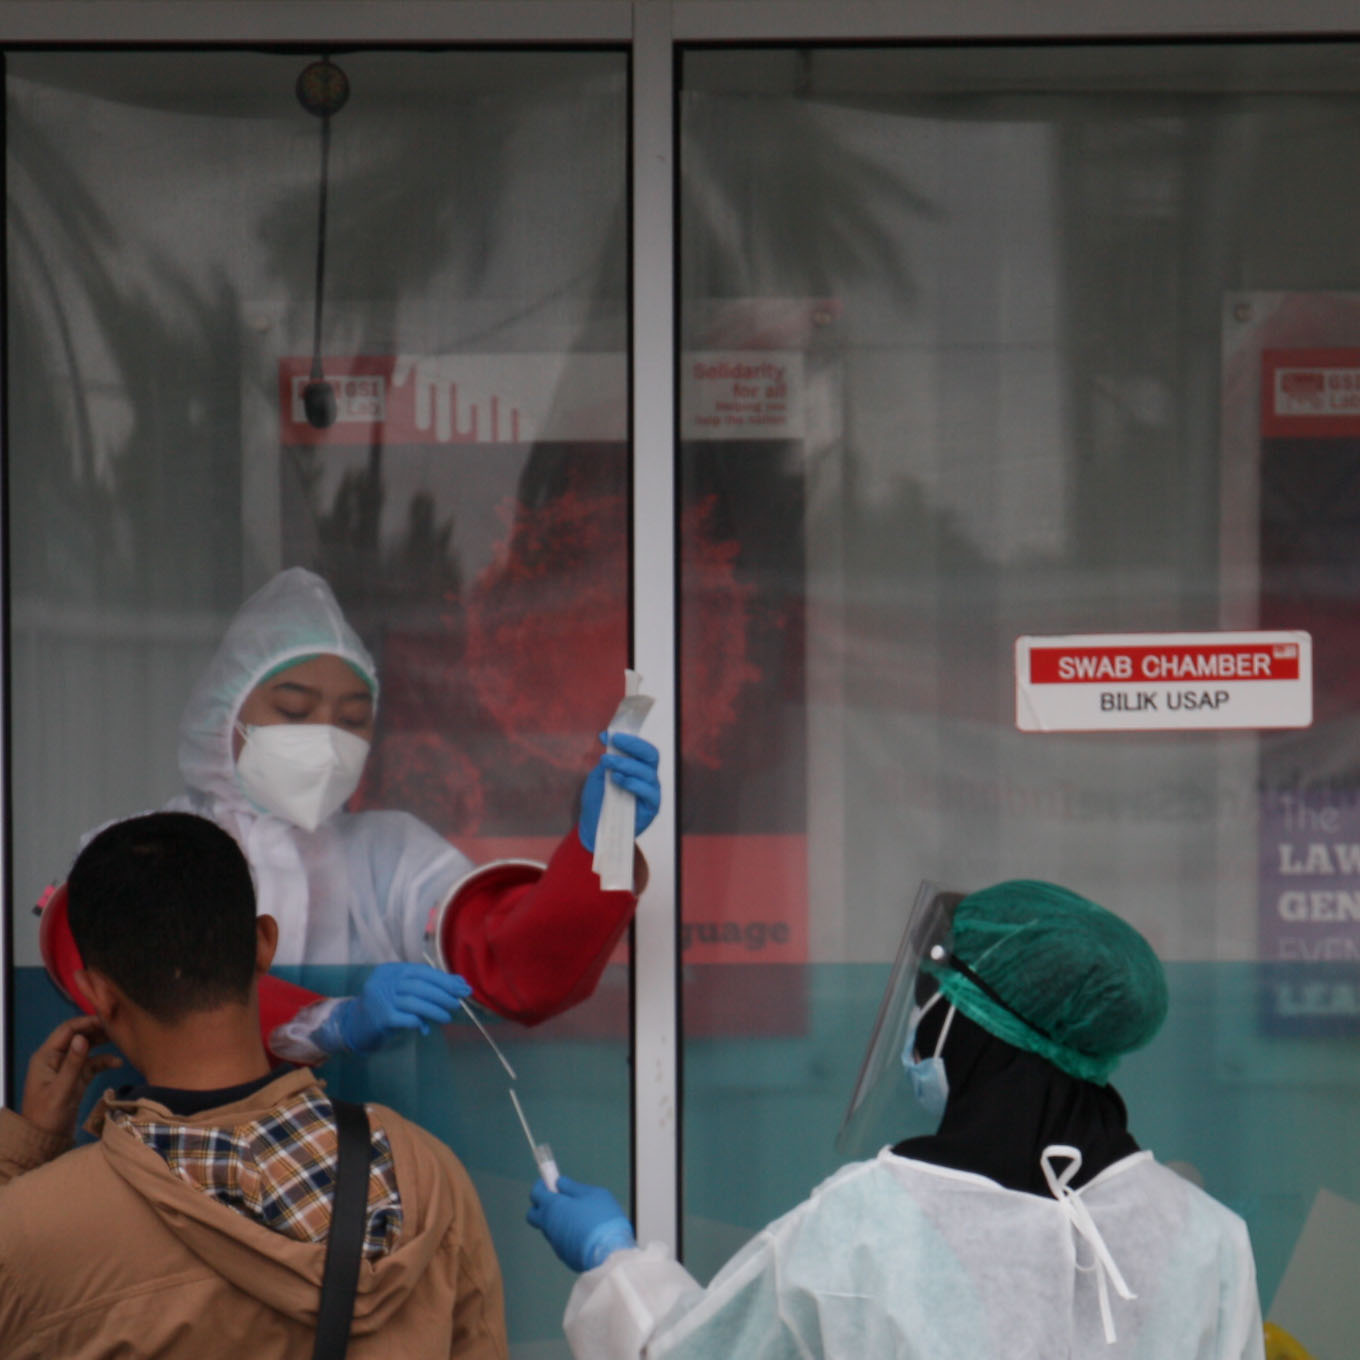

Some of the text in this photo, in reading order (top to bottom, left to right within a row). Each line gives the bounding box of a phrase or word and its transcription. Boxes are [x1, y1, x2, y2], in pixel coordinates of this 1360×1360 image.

[1057, 653, 1272, 680] SWAB CHAMBER
[1100, 691, 1230, 712] BILIK USAP
[1281, 795, 1340, 834] The
[682, 920, 791, 951] guage
